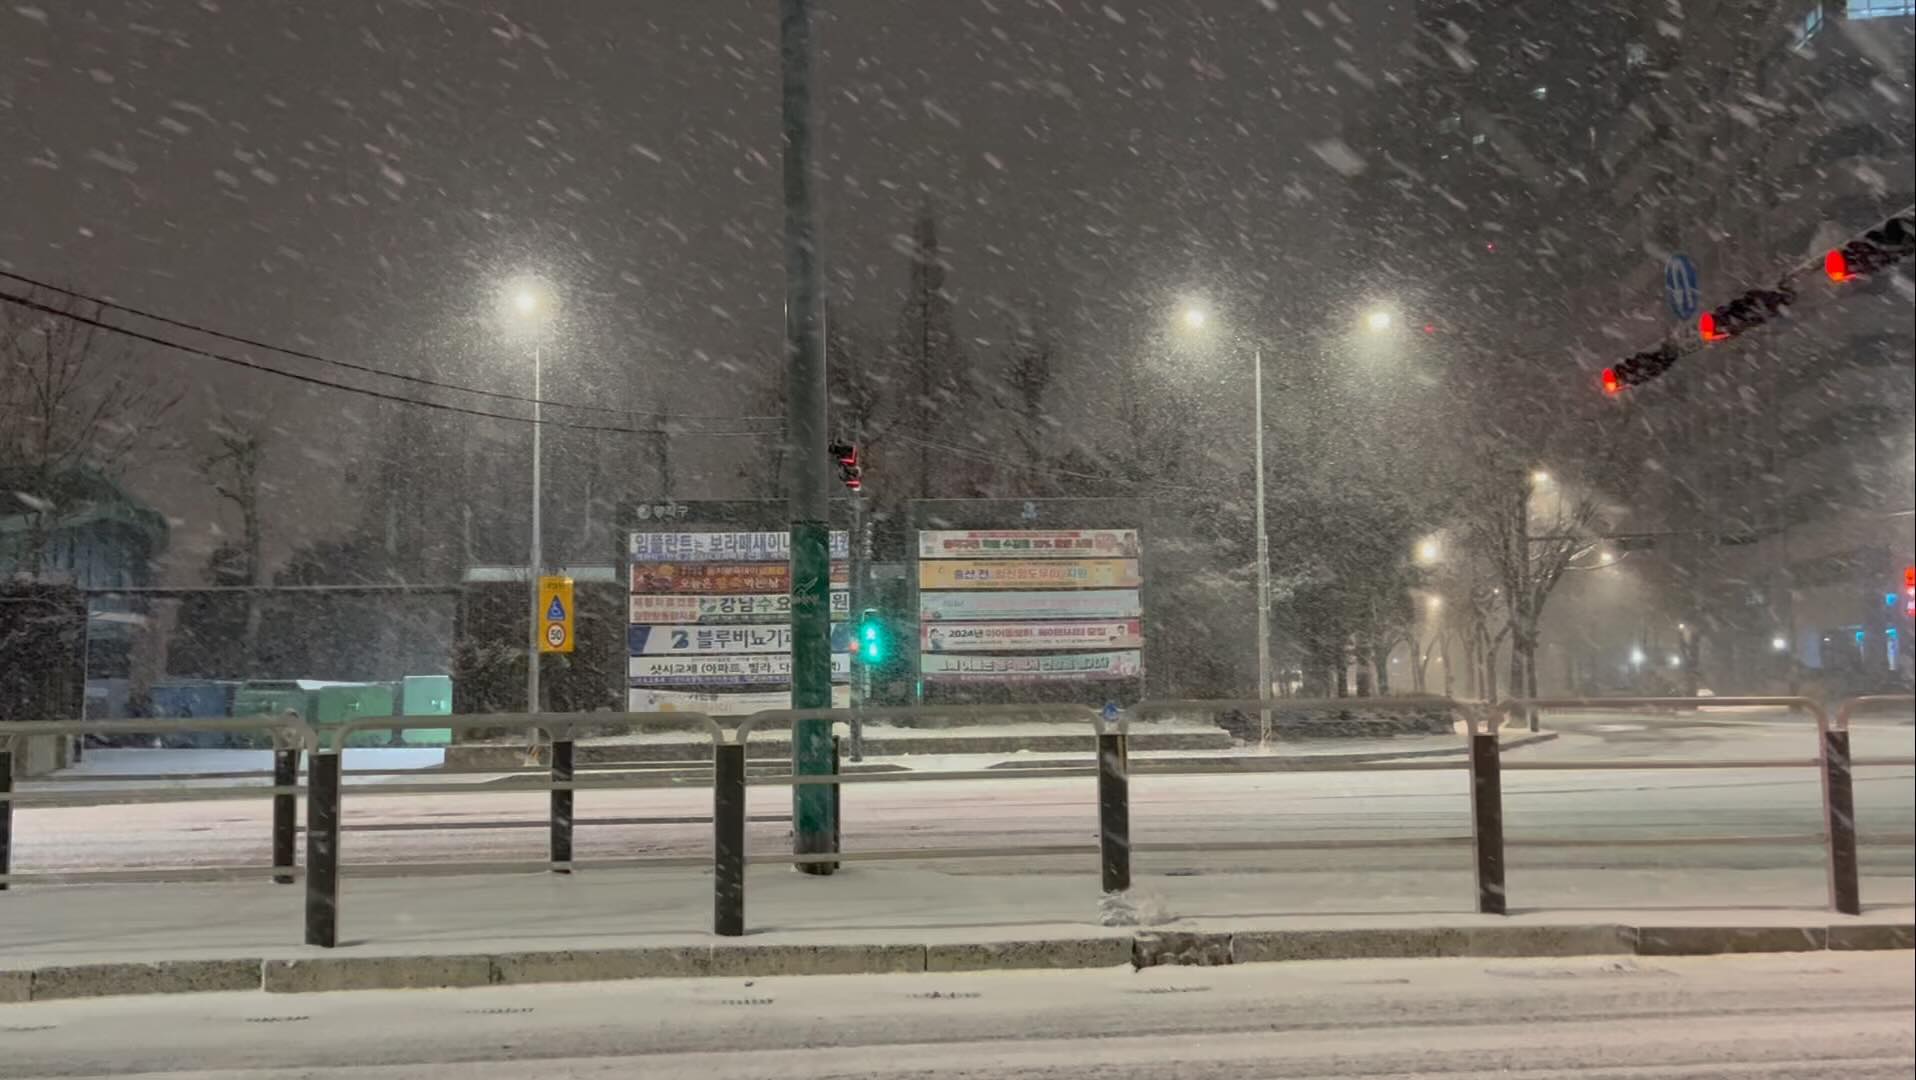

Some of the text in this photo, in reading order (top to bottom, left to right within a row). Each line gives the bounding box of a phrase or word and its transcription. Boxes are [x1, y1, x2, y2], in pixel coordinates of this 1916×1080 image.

[635, 533, 704, 554] 임플란트는
[550, 629, 562, 641] 50
[948, 628, 984, 639] 2024년
